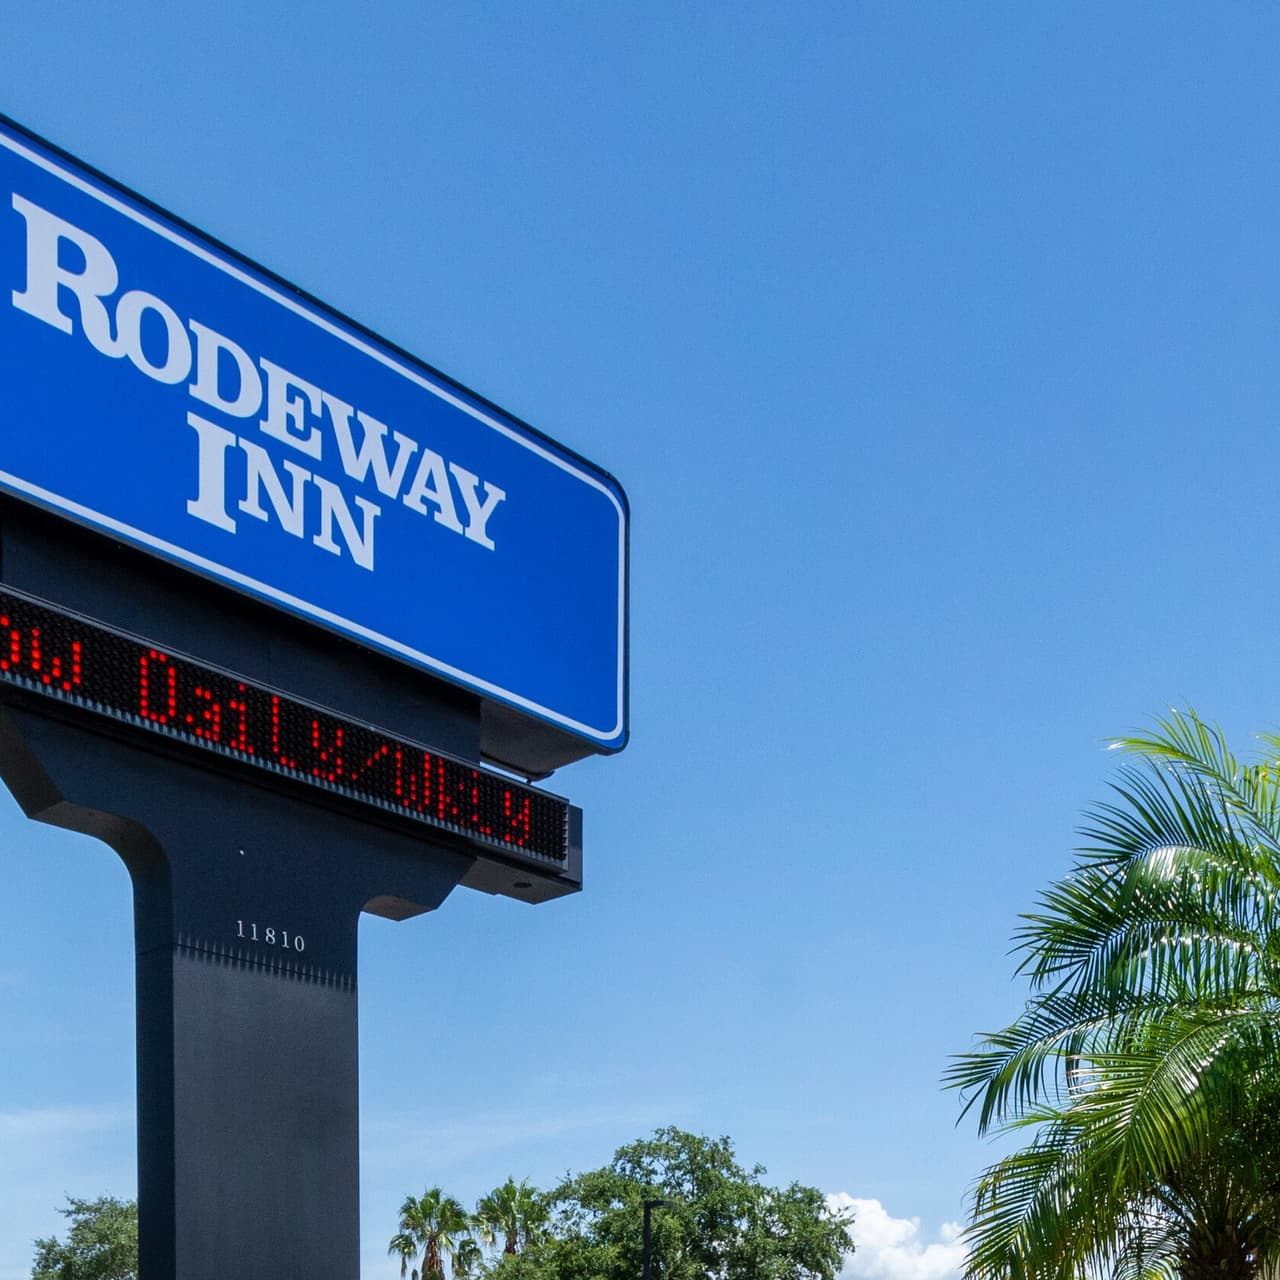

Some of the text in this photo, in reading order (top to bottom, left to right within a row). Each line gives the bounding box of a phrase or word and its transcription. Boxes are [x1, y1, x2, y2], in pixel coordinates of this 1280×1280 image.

[11, 191, 506, 551] RODEWAY
[186, 410, 381, 572] INN
[236, 920, 305, 952] 11810
